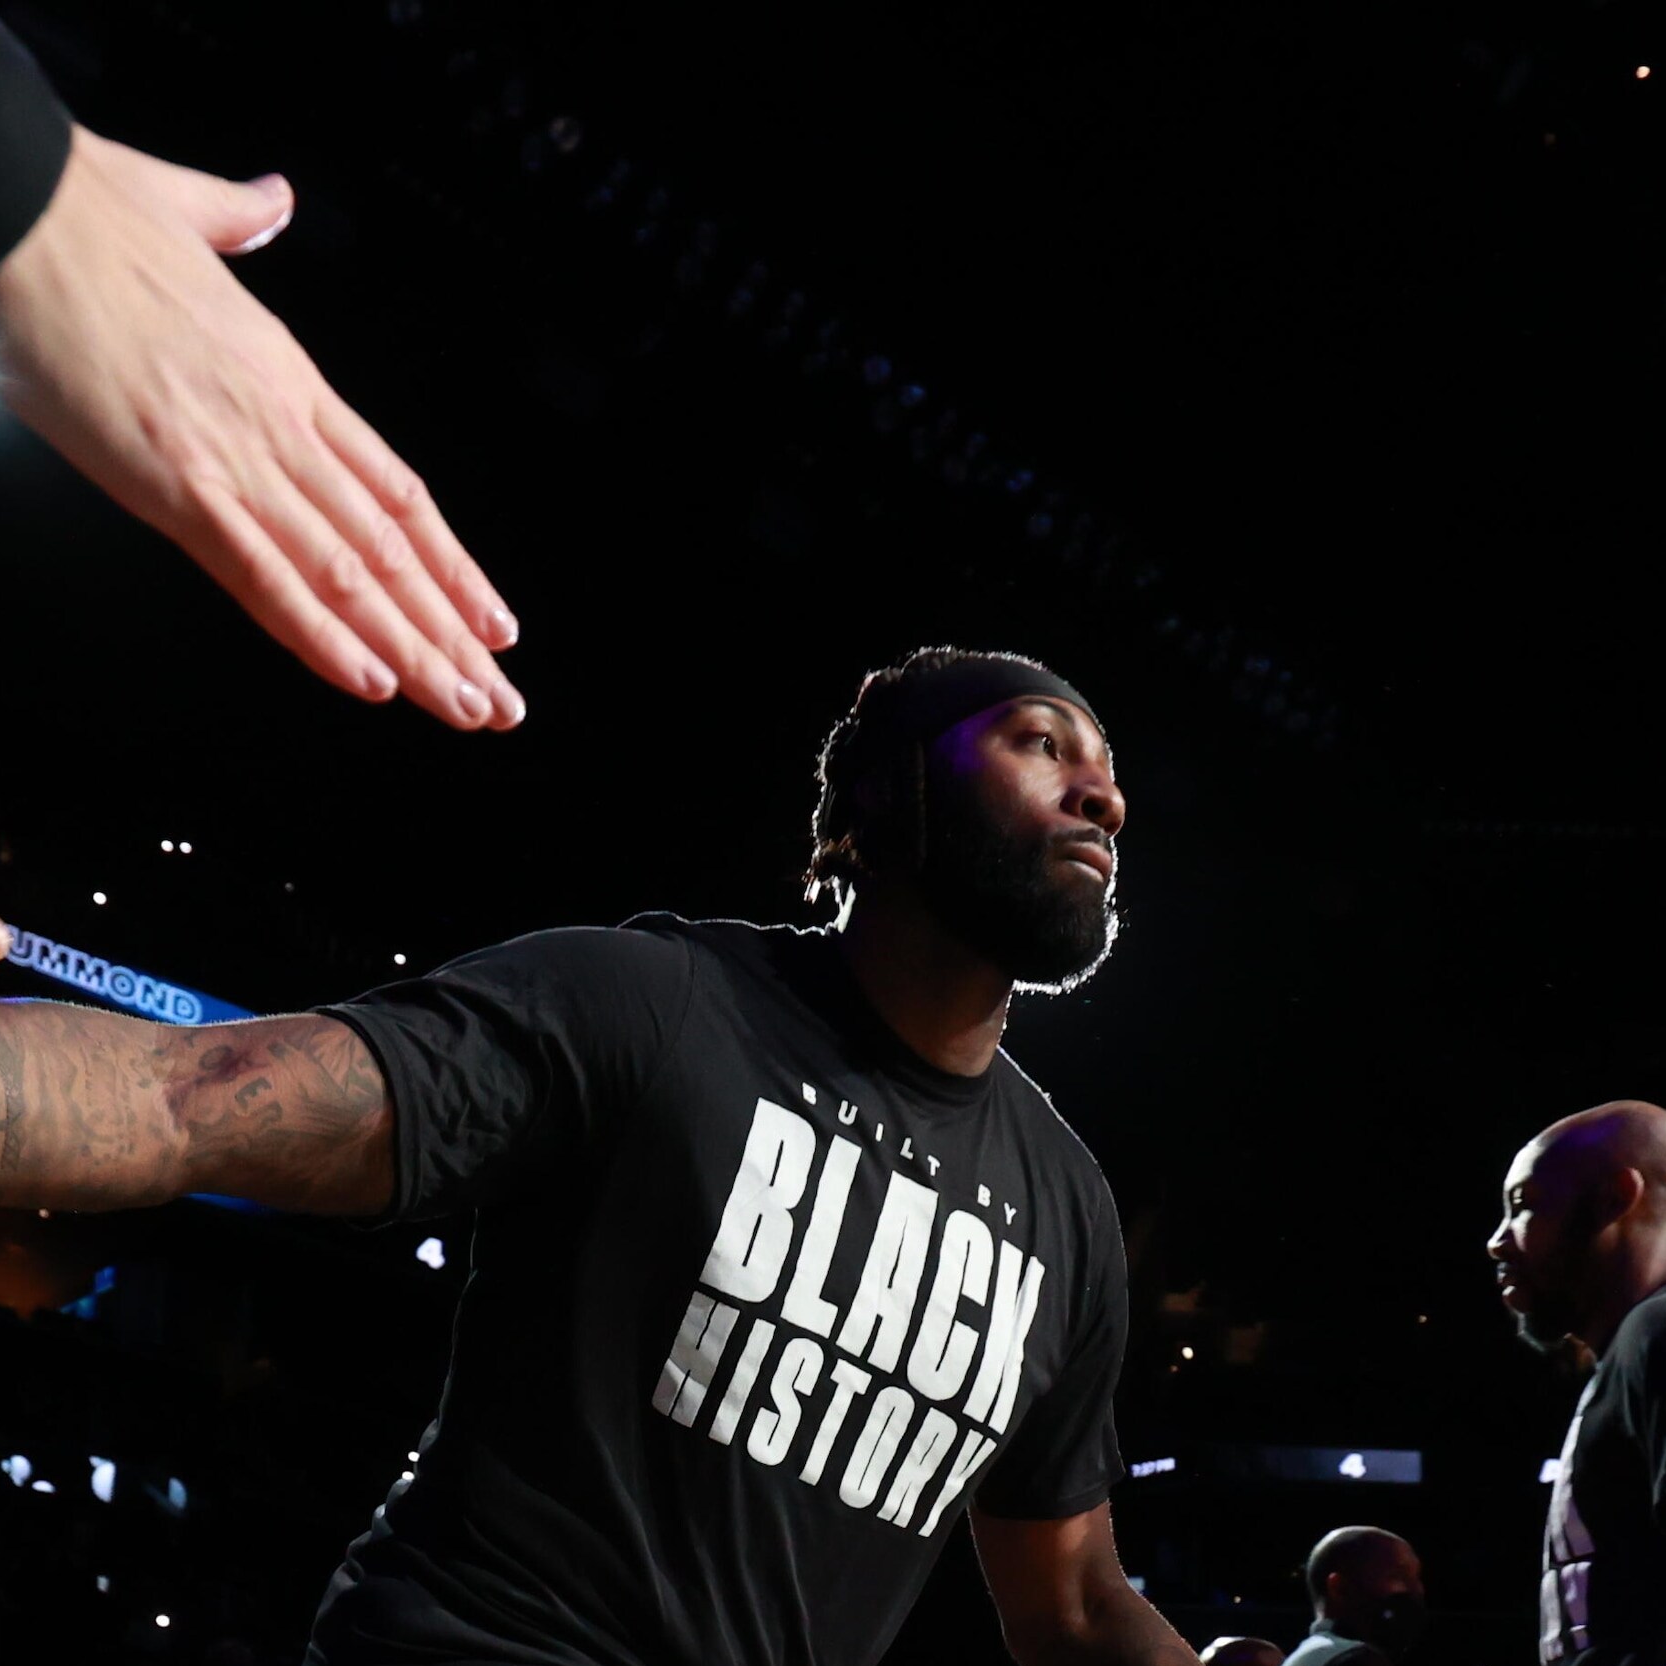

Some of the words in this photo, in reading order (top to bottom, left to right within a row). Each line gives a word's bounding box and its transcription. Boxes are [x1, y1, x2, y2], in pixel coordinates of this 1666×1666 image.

[698, 1096, 1046, 1436] BLACK
[802, 1082, 940, 1177] BUILT
[977, 1183, 1017, 1226] BY
[651, 1289, 998, 1538] HISTORY
